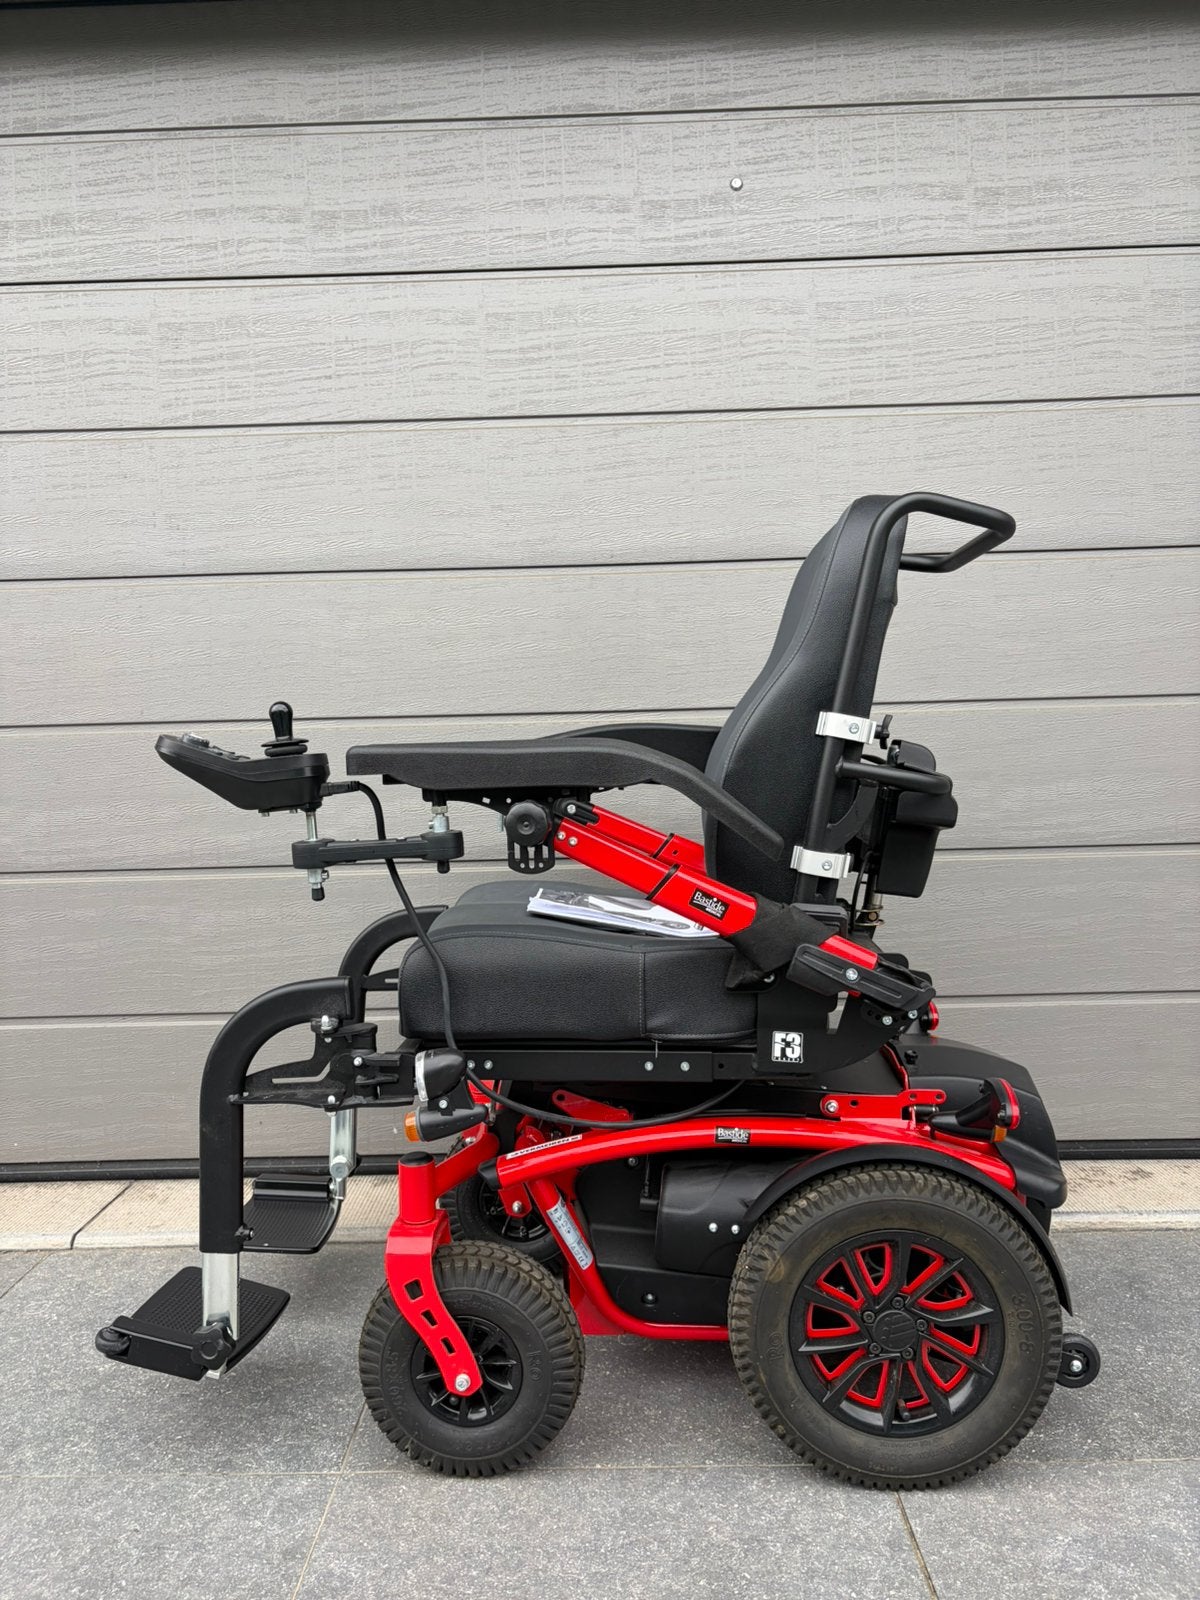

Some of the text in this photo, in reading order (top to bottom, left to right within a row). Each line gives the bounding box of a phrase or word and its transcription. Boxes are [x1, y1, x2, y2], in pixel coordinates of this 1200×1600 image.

[694, 891, 725, 911] Bastide
[774, 1032, 801, 1058] F3
[718, 1128, 749, 1140] Bastide
